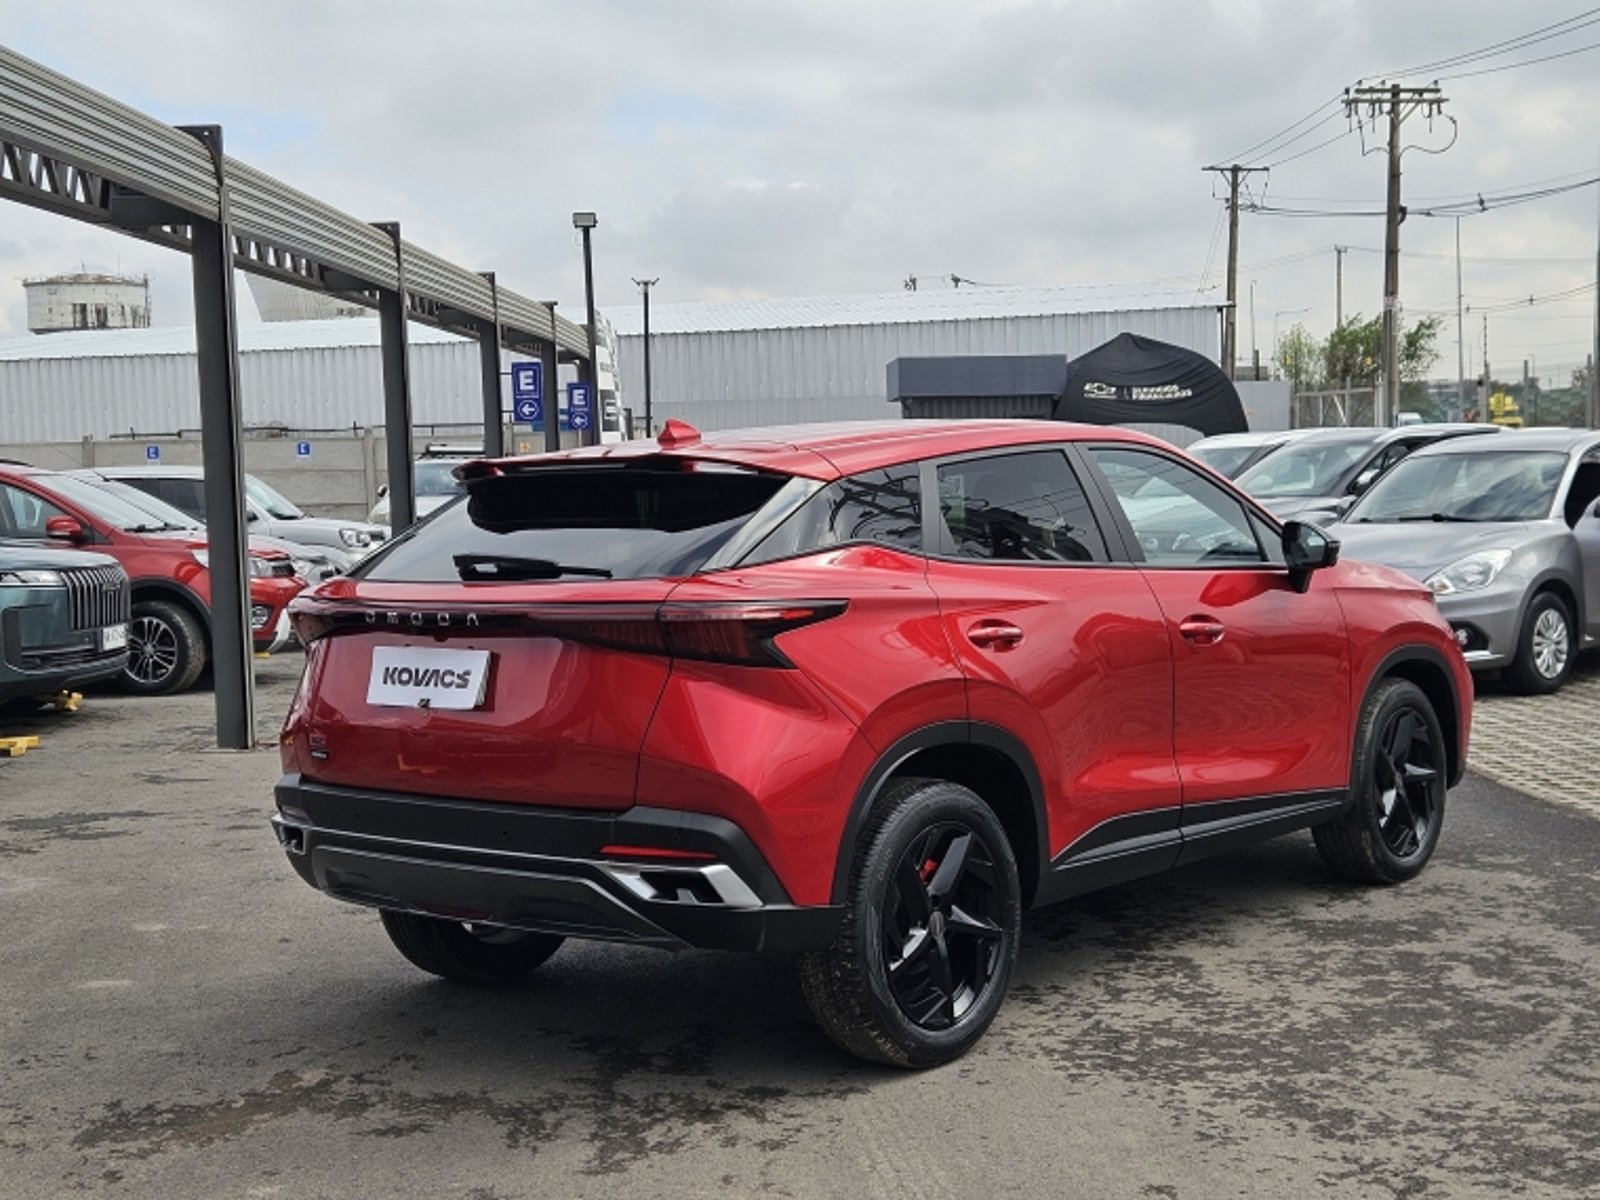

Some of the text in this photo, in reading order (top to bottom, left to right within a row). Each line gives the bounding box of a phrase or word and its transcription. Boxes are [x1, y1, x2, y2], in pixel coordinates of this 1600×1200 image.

[519, 370, 535, 391] E
[572, 389, 586, 405] E
[382, 666, 472, 689] KOVACS
